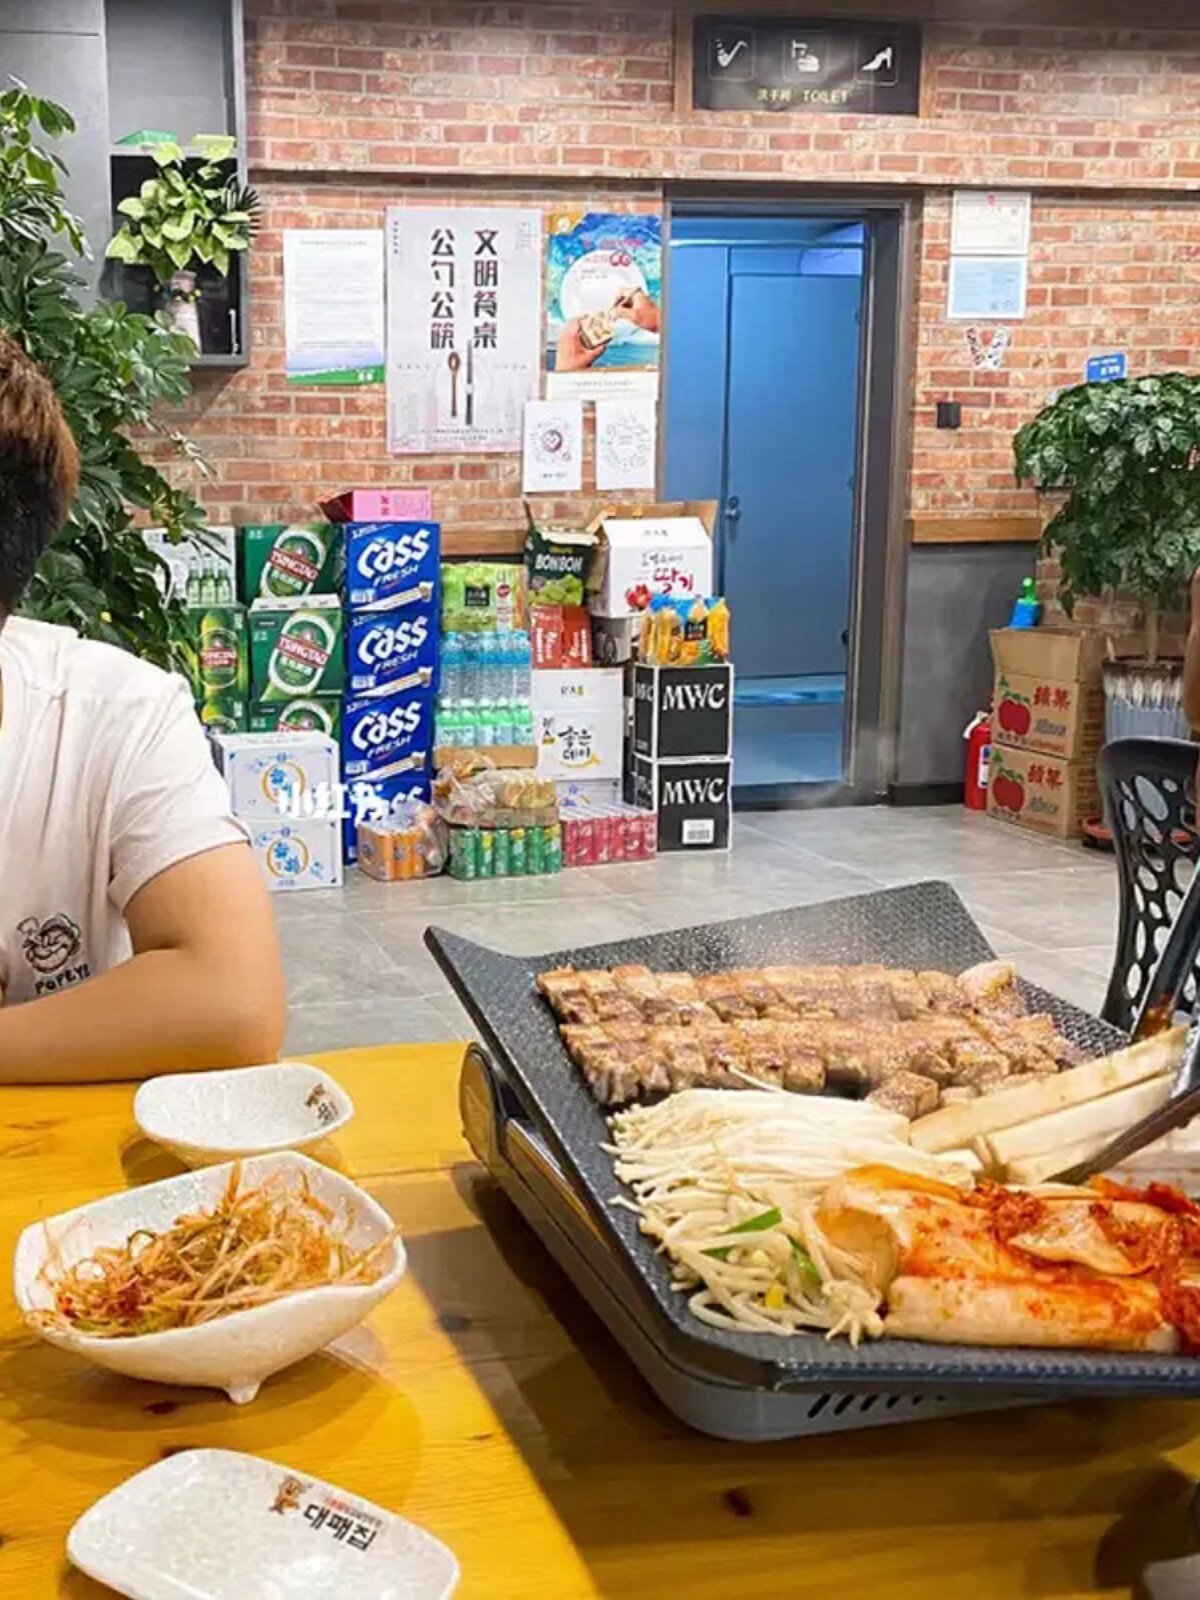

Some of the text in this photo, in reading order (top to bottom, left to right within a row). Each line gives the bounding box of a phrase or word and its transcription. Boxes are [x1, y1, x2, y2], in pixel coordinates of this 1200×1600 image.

[430, 228, 455, 350] 公勺公筷
[474, 228, 499, 349] 文明餐桌
[357, 528, 430, 579] Cass
[357, 615, 428, 665] Cass
[662, 683, 725, 711] MWC
[351, 701, 422, 751] Cass
[662, 777, 725, 806] MWC
[303, 1503, 377, 1551] 대패집
